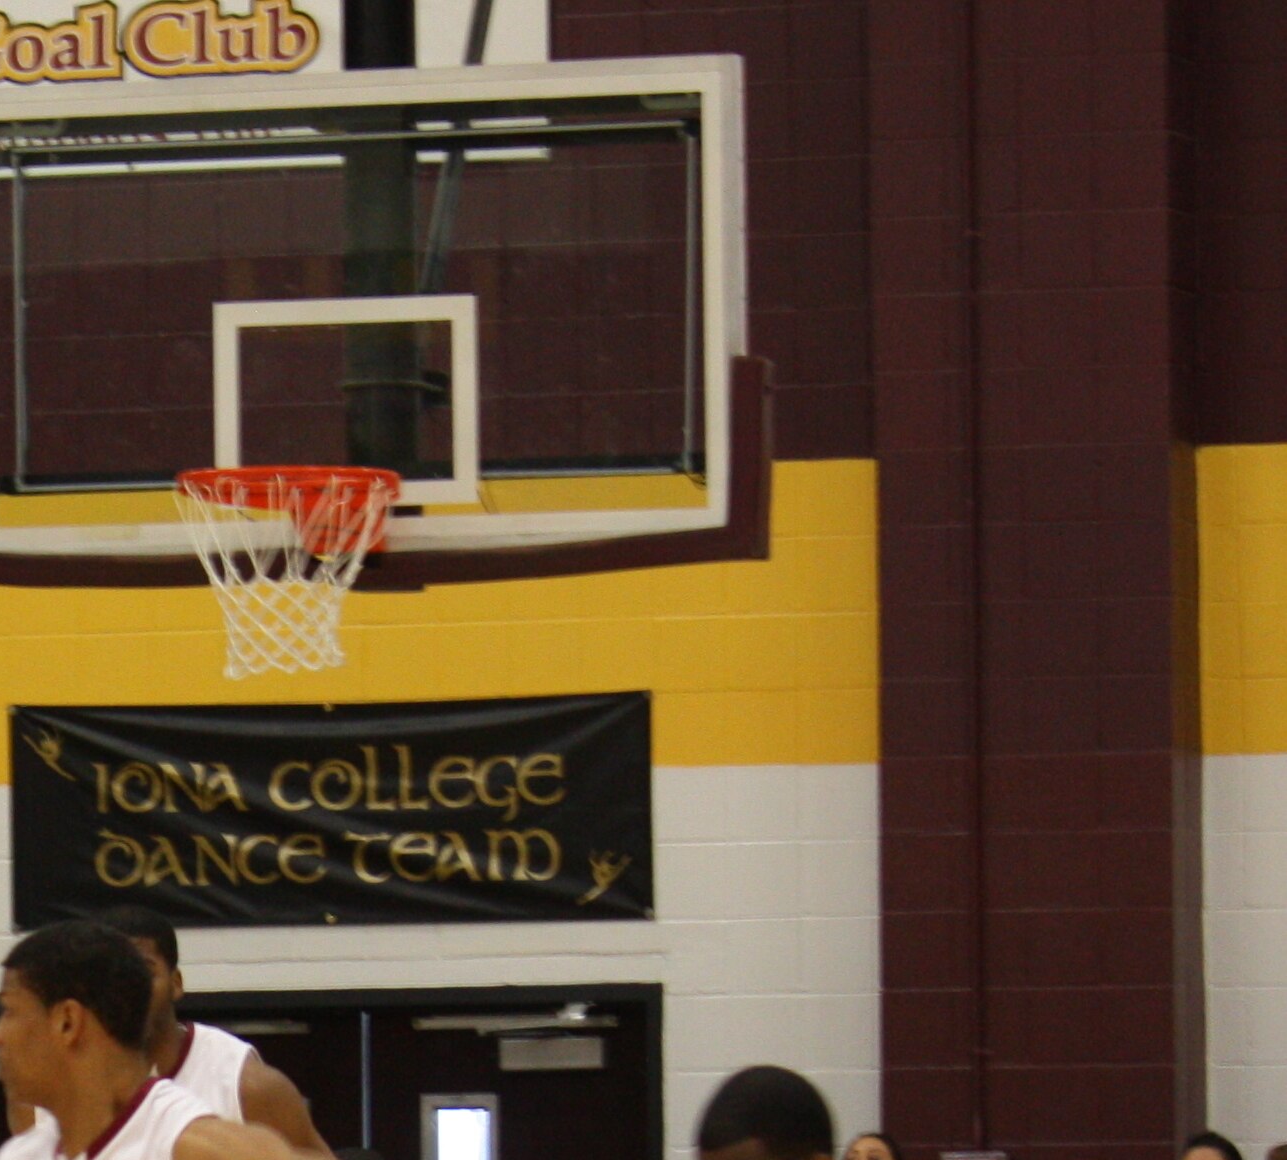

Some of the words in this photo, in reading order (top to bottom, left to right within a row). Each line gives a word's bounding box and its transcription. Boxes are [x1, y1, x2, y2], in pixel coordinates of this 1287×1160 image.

[128, 3, 314, 72] Club
[93, 760, 250, 814] IONA
[268, 745, 566, 821] COLLEGE
[94, 829, 328, 887] DANCE
